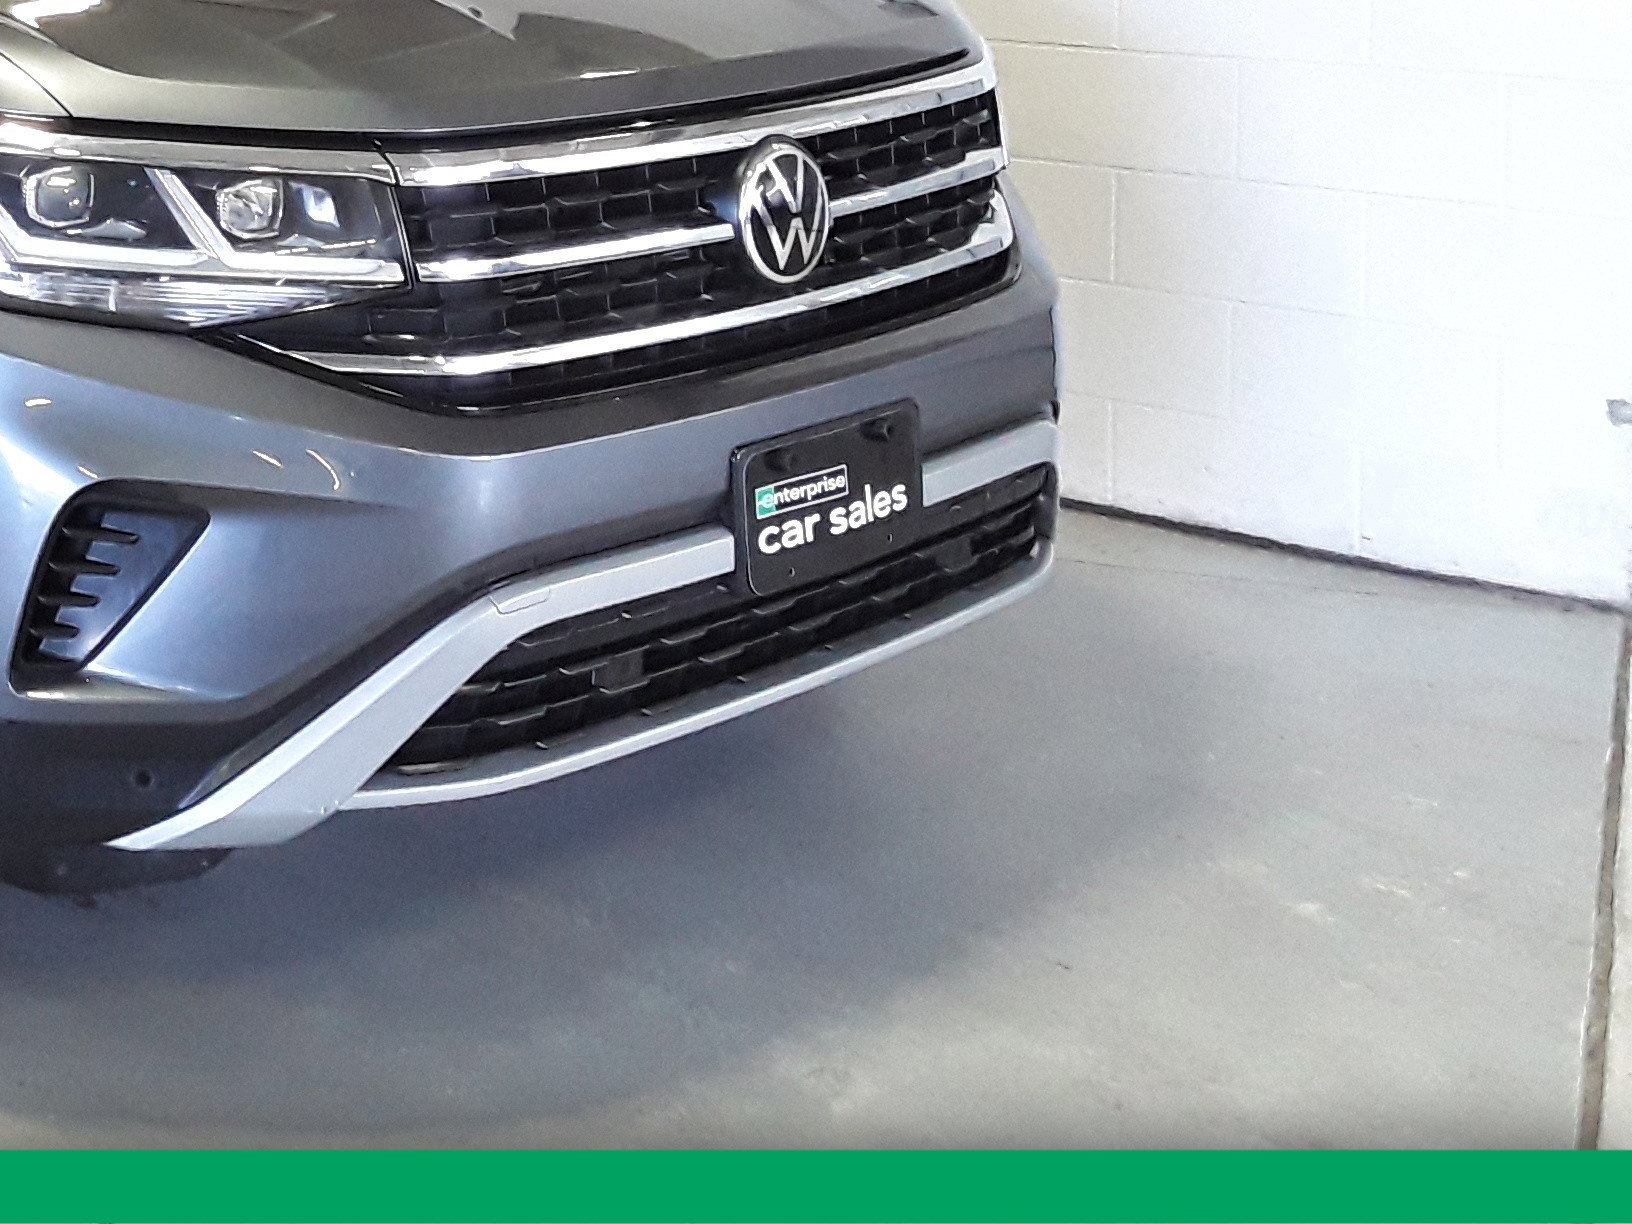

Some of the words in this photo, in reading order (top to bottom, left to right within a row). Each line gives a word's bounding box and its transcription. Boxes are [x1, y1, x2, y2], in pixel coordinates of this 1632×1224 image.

[757, 511, 821, 555] car
[828, 483, 909, 536] sales
[760, 474, 846, 511] enterprise
